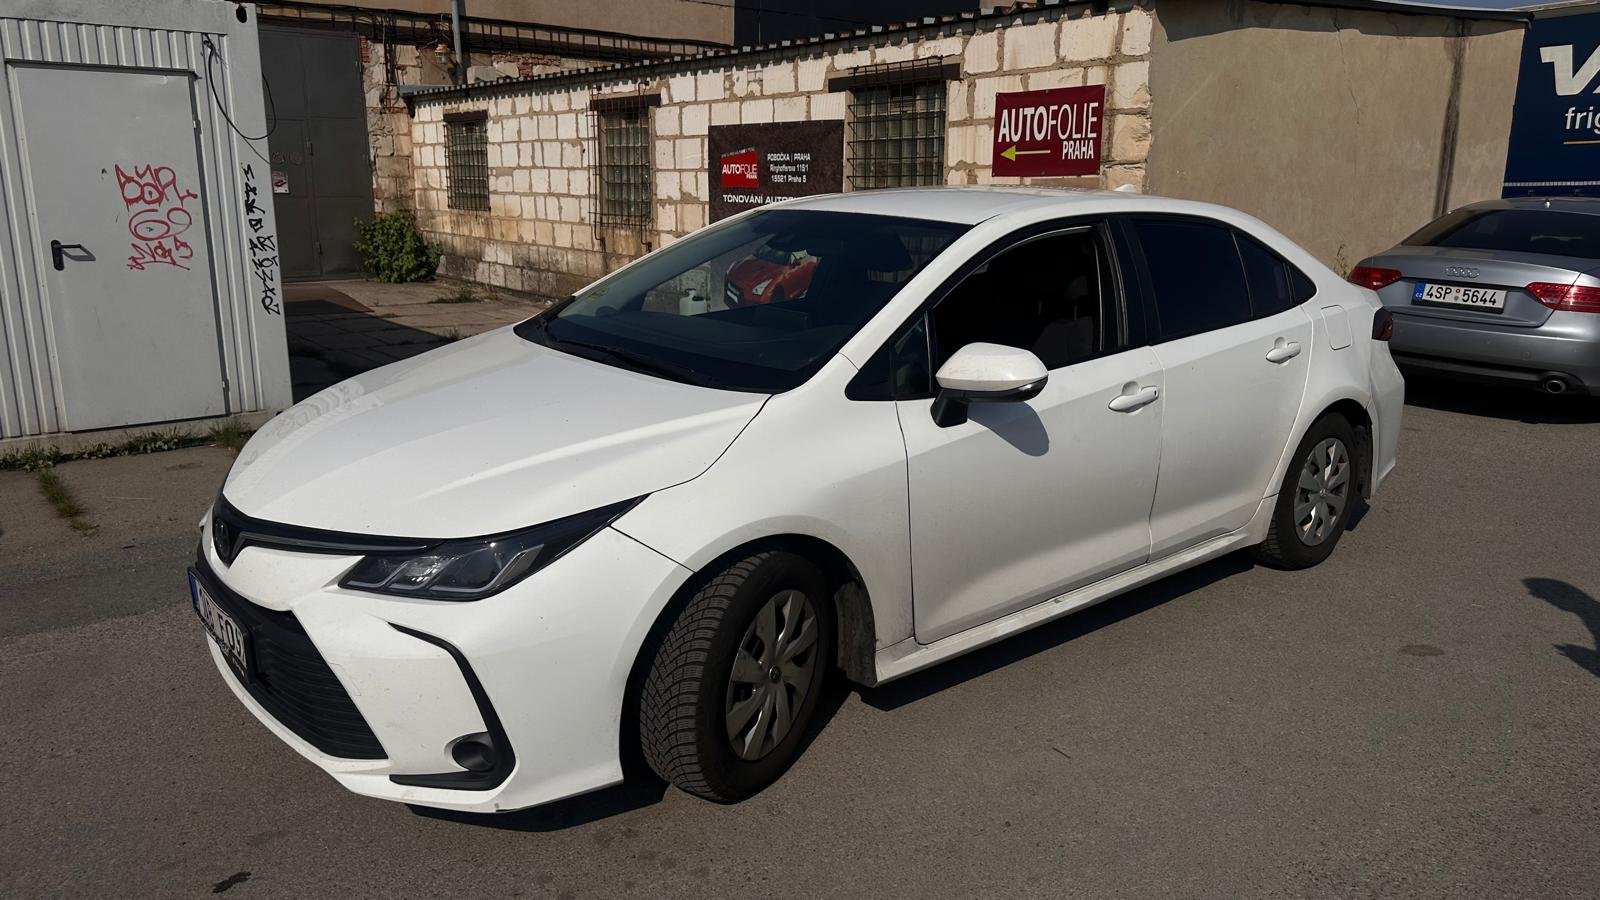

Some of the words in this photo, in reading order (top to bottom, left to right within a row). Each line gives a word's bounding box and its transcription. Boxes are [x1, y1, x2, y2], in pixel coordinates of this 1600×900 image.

[1540, 44, 1600, 96] V
[998, 102, 1099, 143] AUTOFOLIE
[767, 152, 789, 161] POBOČKA
[793, 153, 810, 161] PRAHA
[1062, 140, 1095, 160] PRAHA
[1426, 285, 1453, 300] 4SP
[1462, 289, 1497, 306] 5644
